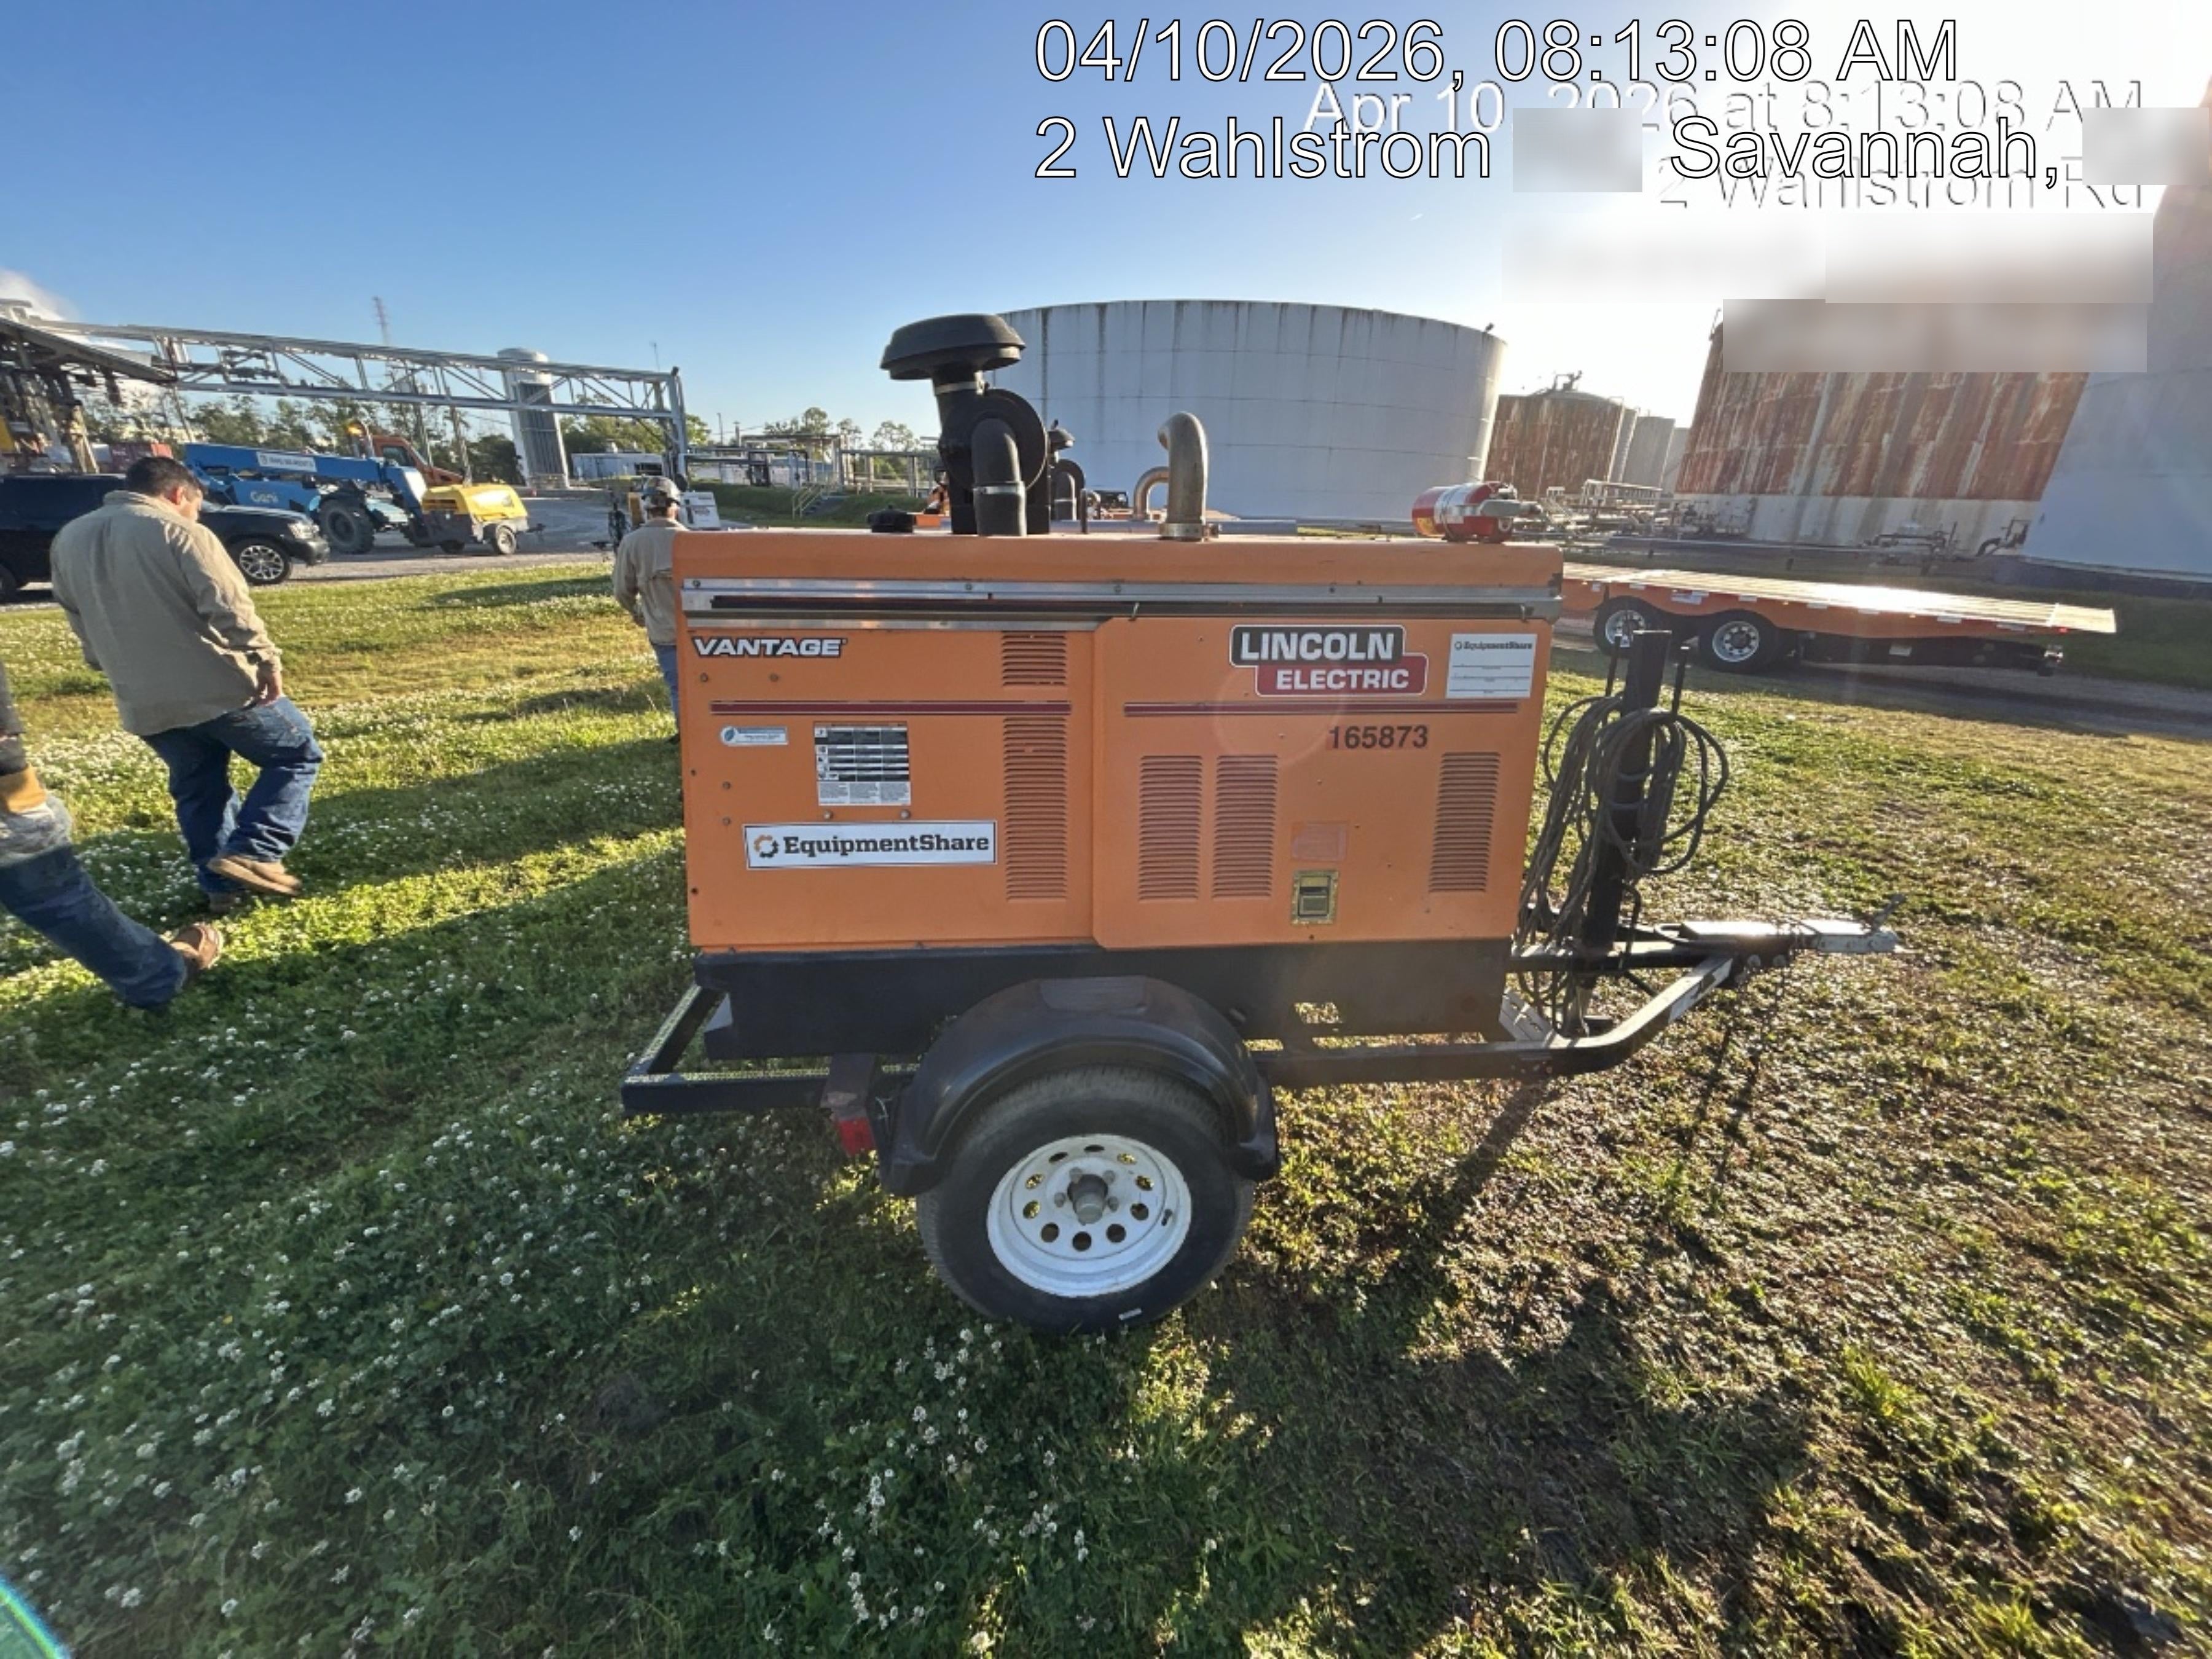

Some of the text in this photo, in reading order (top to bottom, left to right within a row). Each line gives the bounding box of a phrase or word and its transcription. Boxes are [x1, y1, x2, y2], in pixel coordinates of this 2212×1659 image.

[694, 638, 842, 656] VANTAGE
[1240, 632, 1395, 661] LINCOLN
[1276, 668, 1410, 690] ELECTRIC
[1329, 724, 1429, 750] 165873
[783, 834, 989, 858] EquipmentShare
